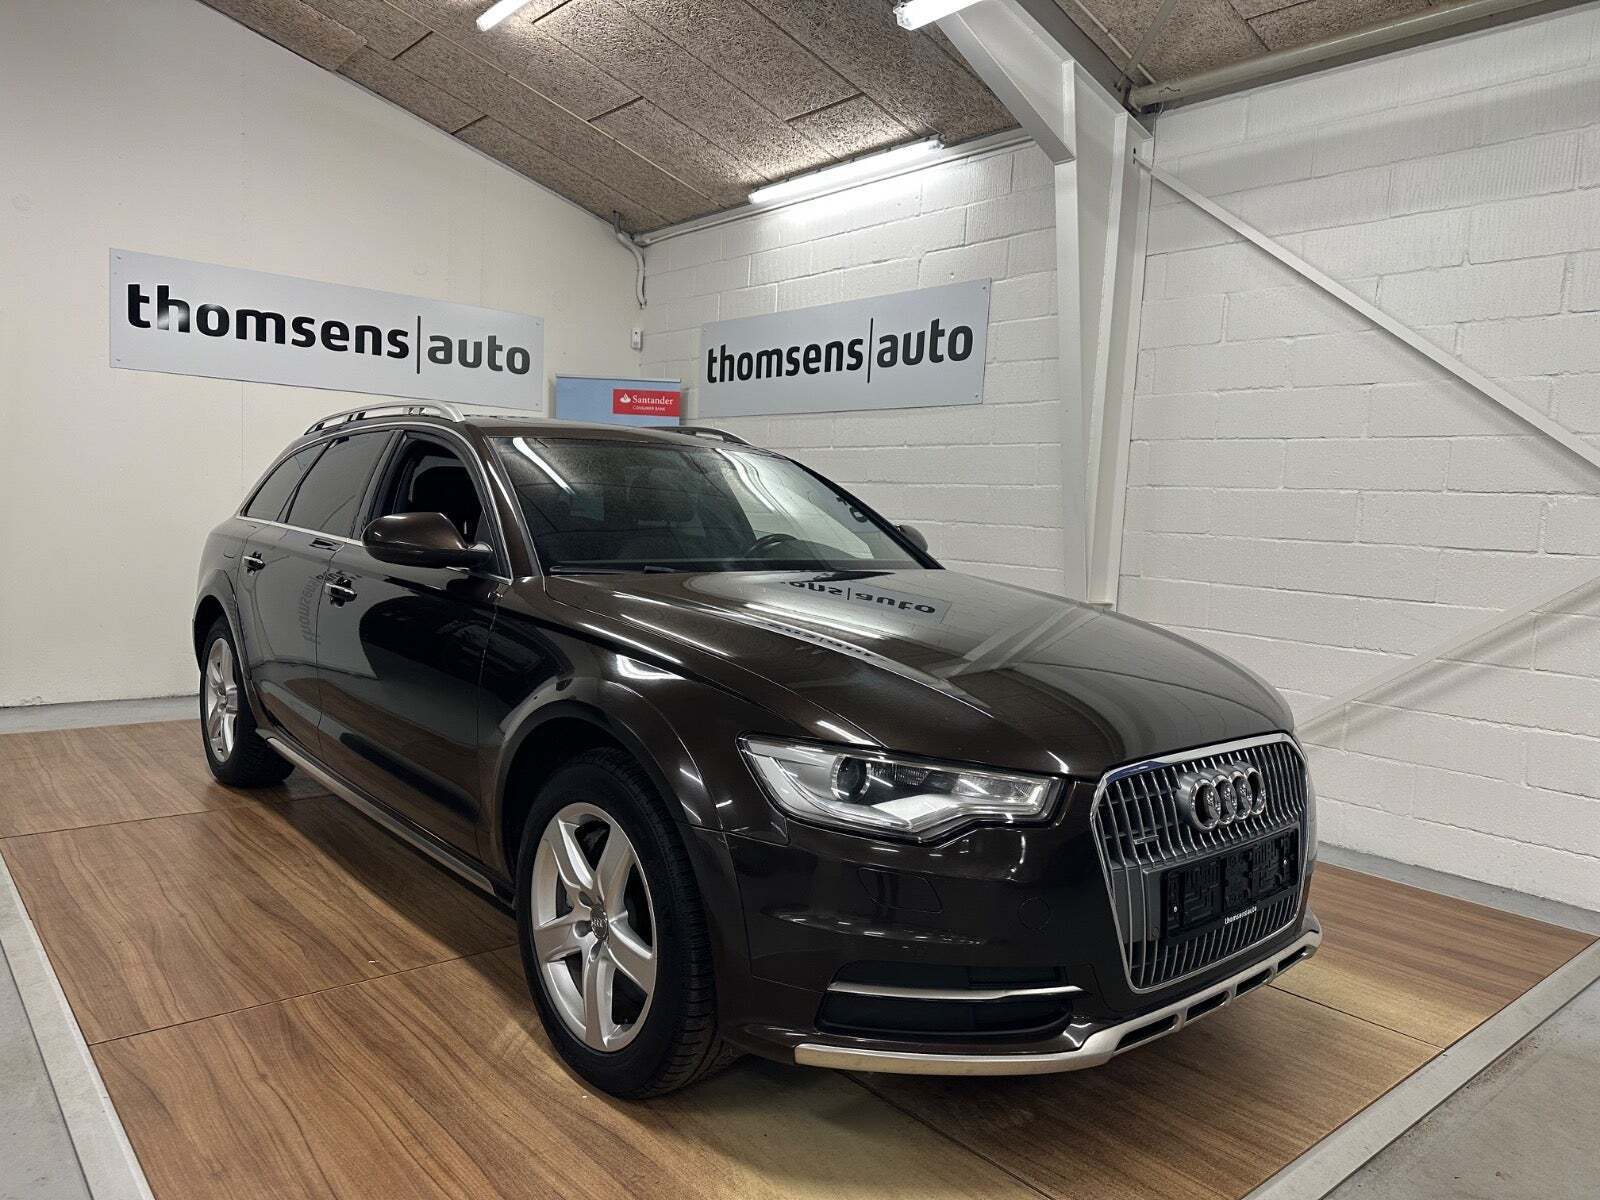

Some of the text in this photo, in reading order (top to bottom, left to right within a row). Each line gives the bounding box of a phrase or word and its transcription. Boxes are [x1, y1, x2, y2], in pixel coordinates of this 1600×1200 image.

[127, 283, 531, 375] thomsens auto
[706, 318, 974, 384] thomsens auto
[631, 395, 673, 405] Santander
